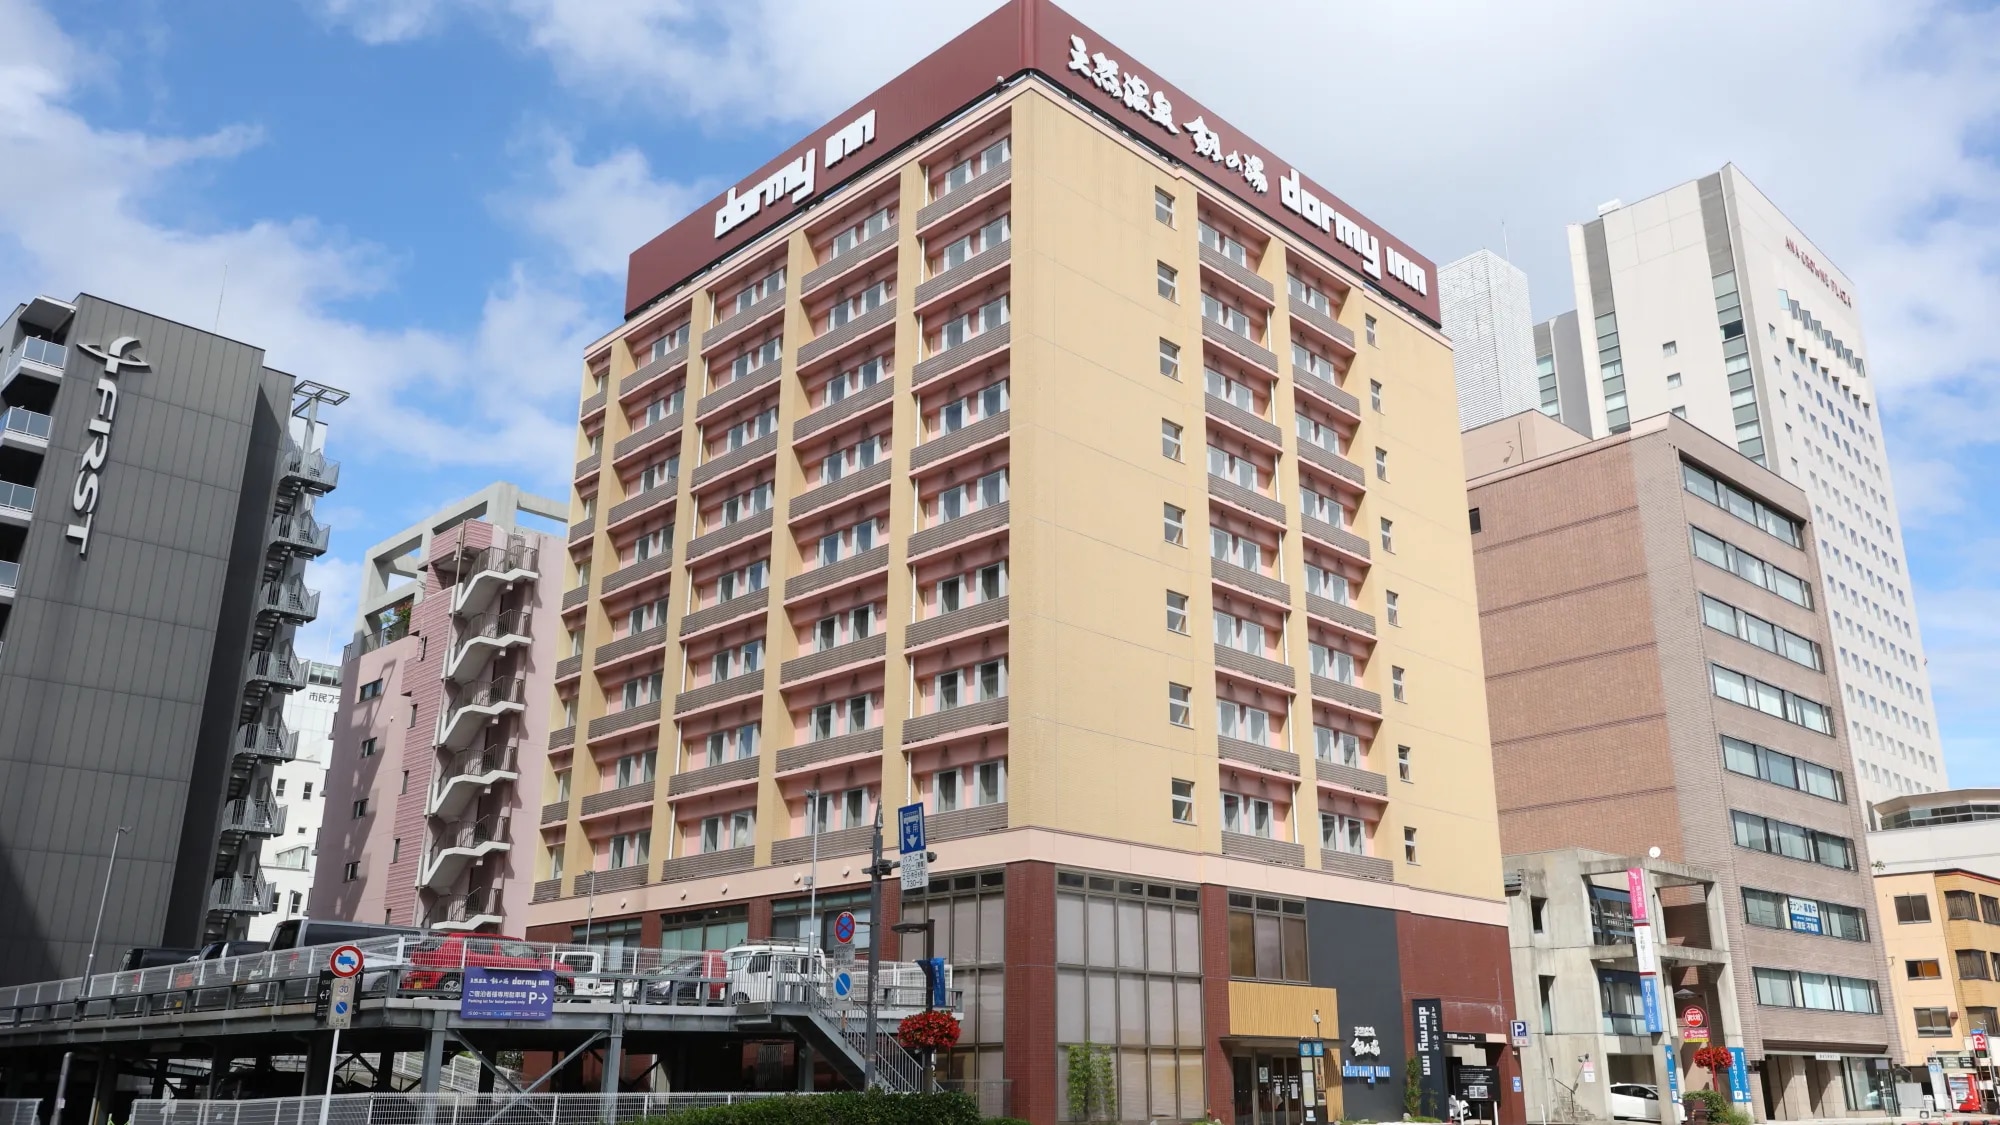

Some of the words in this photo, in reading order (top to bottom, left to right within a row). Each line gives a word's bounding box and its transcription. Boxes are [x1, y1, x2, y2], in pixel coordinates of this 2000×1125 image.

[1068, 34, 1180, 134] 天然温泉
[714, 148, 816, 229] dormy
[825, 109, 876, 168] inn
[1280, 168, 1381, 280] dormy
[1386, 246, 1428, 296] inn
[1785, 235, 1800, 259] ANA
[1830, 279, 1852, 309] PLAZA
[66, 378, 118, 555] FIRST
[339, 985, 349, 994] 30
[512, 977, 537, 987] dormy
[529, 991, 538, 1005] P
[1418, 1006, 1430, 1052] dormy
[1513, 1022, 1525, 1037] P
[1342, 1059, 1375, 1084] dormy
[1375, 1065, 1391, 1078] inn
[1422, 1056, 1431, 1075] inn
